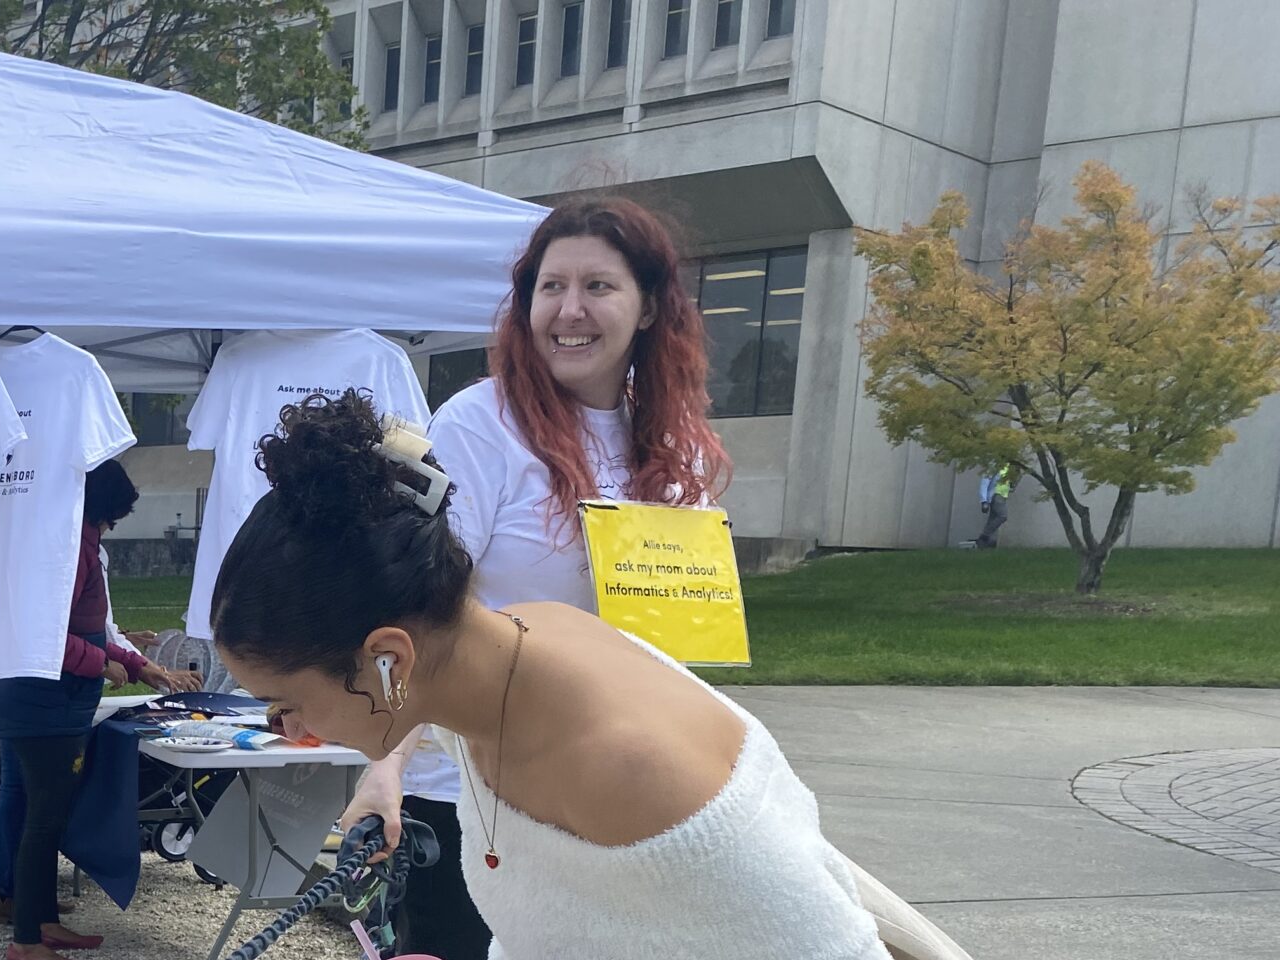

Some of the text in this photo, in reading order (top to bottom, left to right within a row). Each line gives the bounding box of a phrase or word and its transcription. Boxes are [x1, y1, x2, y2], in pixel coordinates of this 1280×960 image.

[277, 385, 294, 393] Ask
[312, 387, 340, 396] about
[17, 409, 32, 417] out
[643, 539, 684, 554] Allie says,
[615, 560, 718, 577] ask my mom about
[605, 582, 734, 603] Informatics & Analytics!
